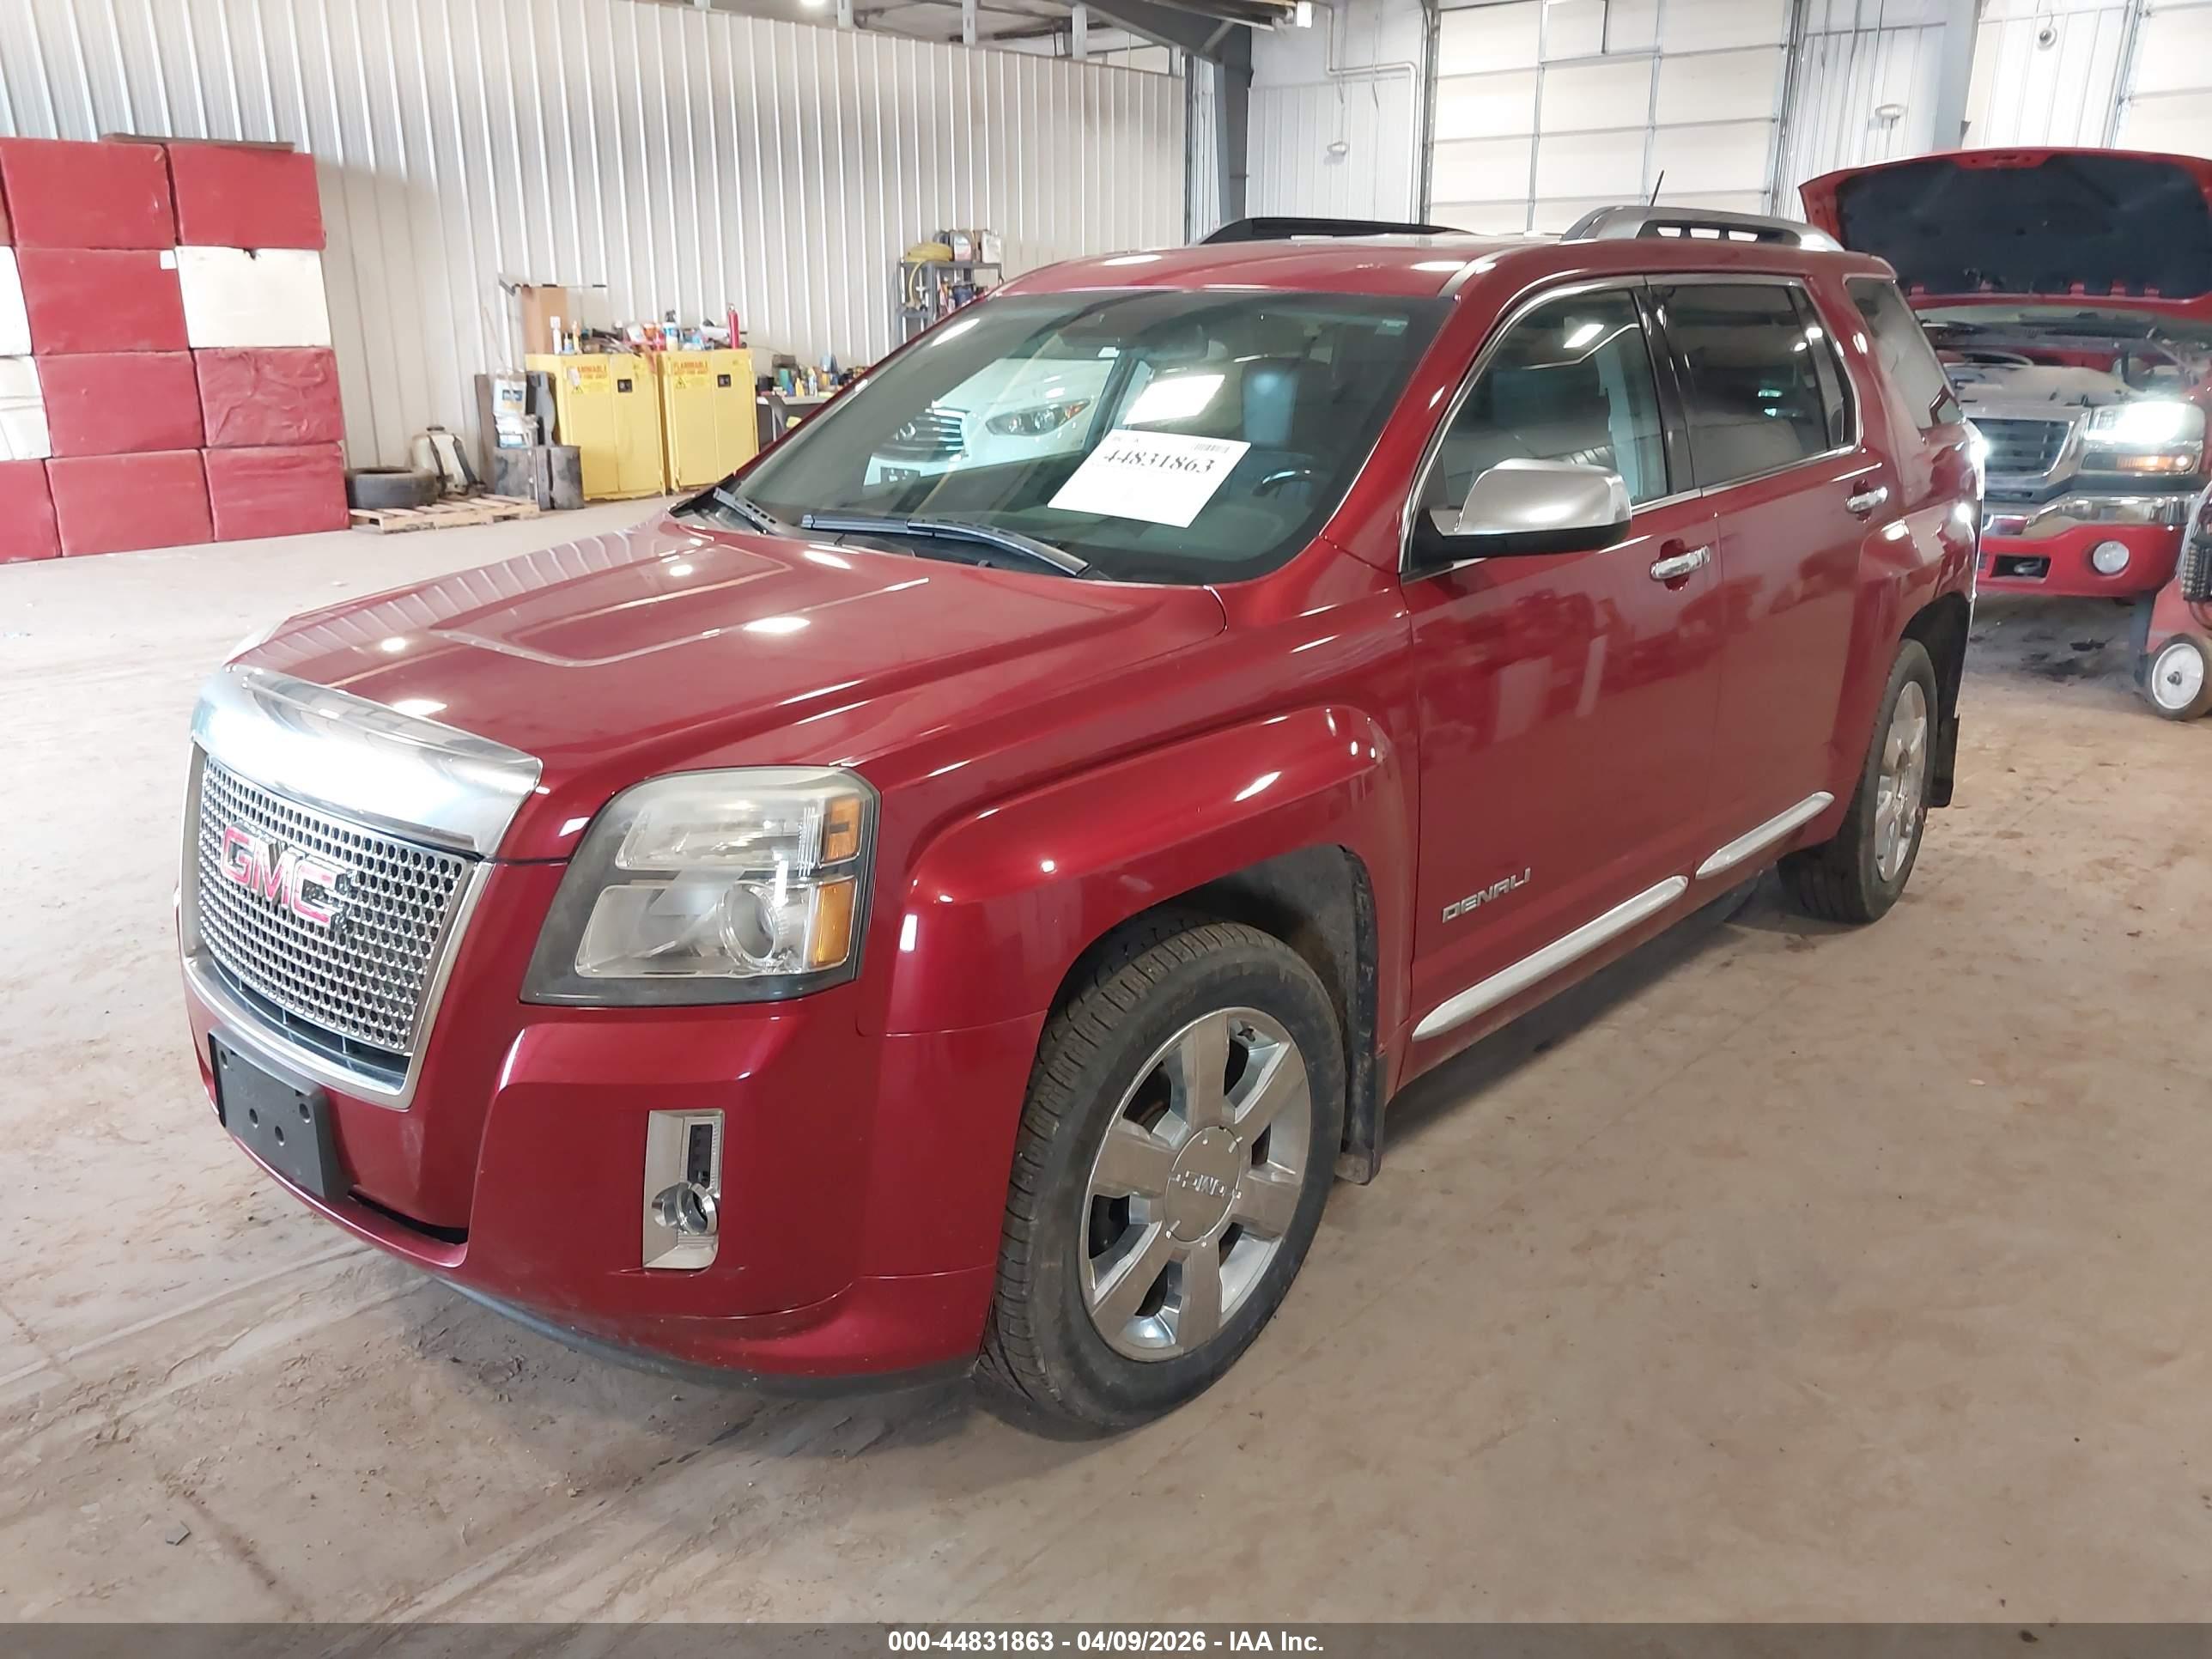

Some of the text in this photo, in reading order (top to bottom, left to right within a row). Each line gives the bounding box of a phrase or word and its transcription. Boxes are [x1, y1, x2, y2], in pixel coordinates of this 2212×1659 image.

[1103, 449, 1215, 473] 44831863
[220, 824, 341, 927] GMC
[1442, 866, 1532, 924] DENALI
